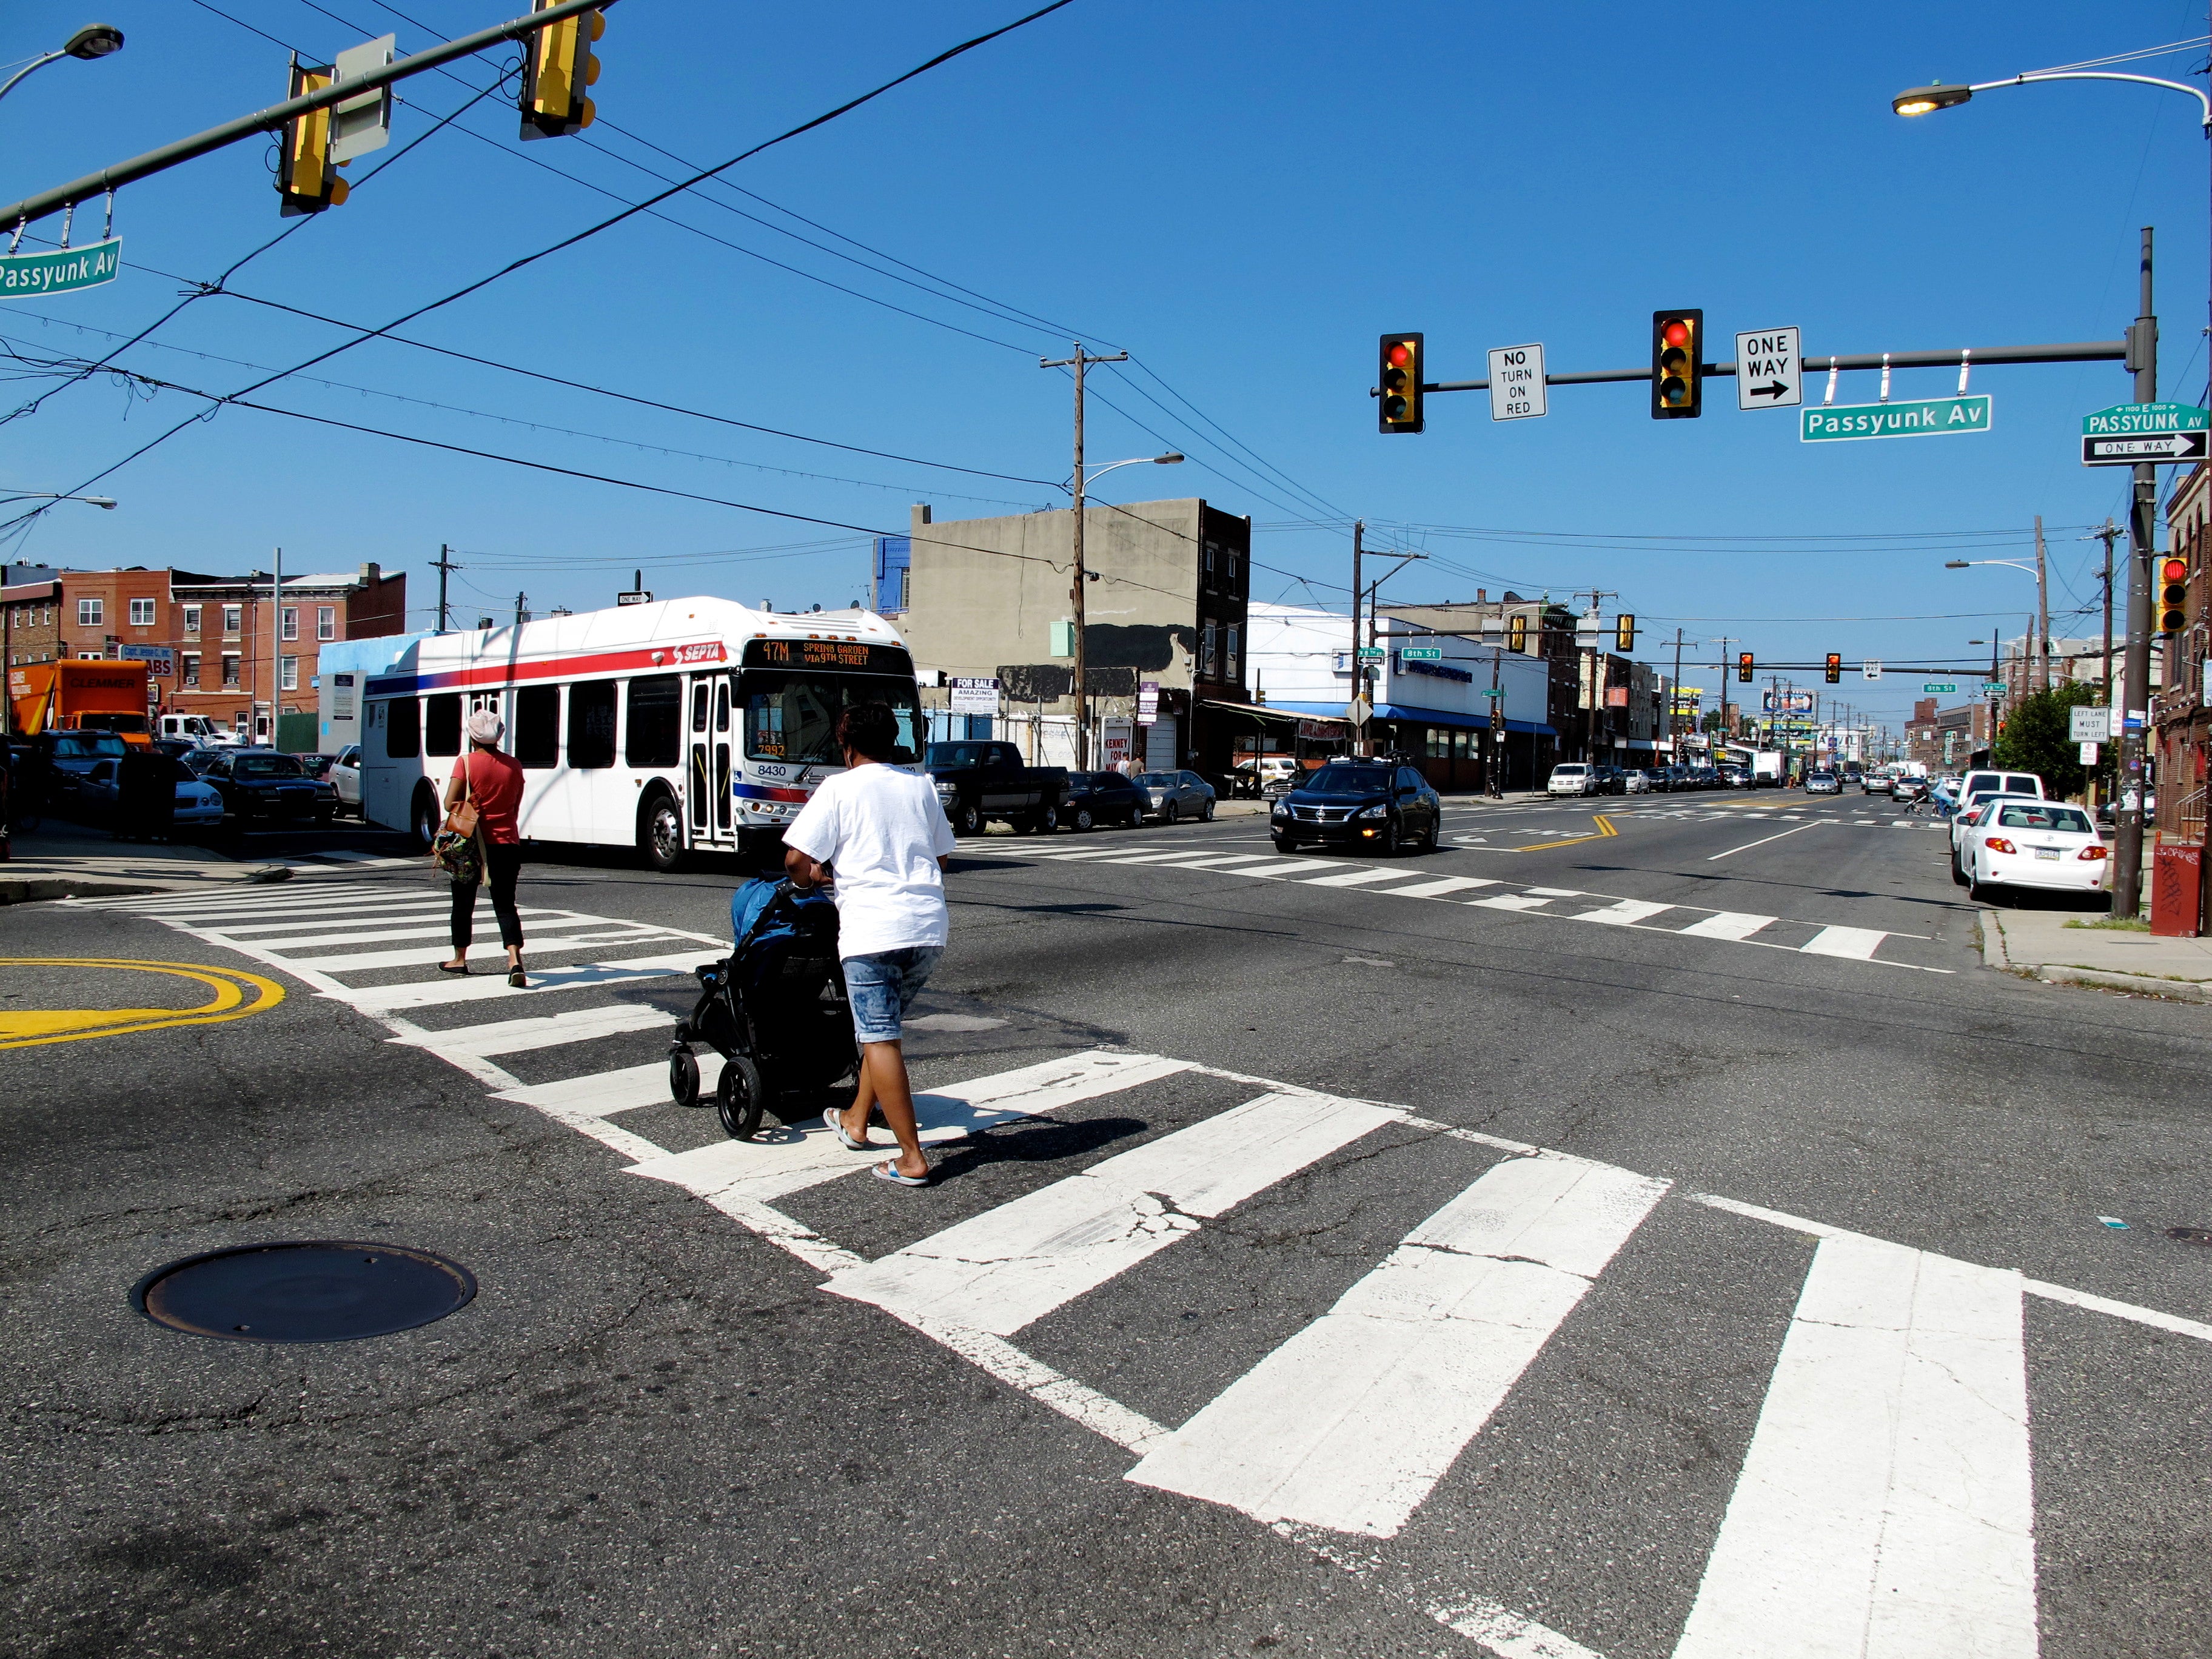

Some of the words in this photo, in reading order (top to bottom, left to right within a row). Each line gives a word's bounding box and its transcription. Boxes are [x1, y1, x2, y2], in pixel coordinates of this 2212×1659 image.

[94, 252, 115, 275] Av
[1747, 335, 1788, 355] ONE
[1504, 351, 1526, 366] NO
[1748, 357, 1788, 377] WAY
[1501, 369, 1532, 383] TURN
[1509, 386, 1526, 398] ON
[1507, 401, 1530, 415] RED
[1809, 406, 1936, 435] Passyunk
[1947, 404, 1982, 425] Av
[2090, 412, 2179, 432] PASSYUNK
[2187, 416, 2202, 428] AV
[2105, 443, 2134, 454] ONE
[2143, 441, 2173, 452] WAY
[684, 643, 720, 661] SEPTA
[763, 642, 788, 661] 47M
[837, 645, 868, 655] GARDEN
[805, 654, 819, 663] VIA
[820, 654, 837, 663] 9TH
[839, 654, 868, 665] STREET
[70, 678, 135, 689] CLEMMER
[957, 679, 973, 688] FOR
[974, 679, 994, 688] SALE
[758, 745, 785, 756] 7992
[1105, 738, 1128, 749] KENNEY
[1110, 751, 1122, 760] FOR
[758, 765, 786, 776] 8430
